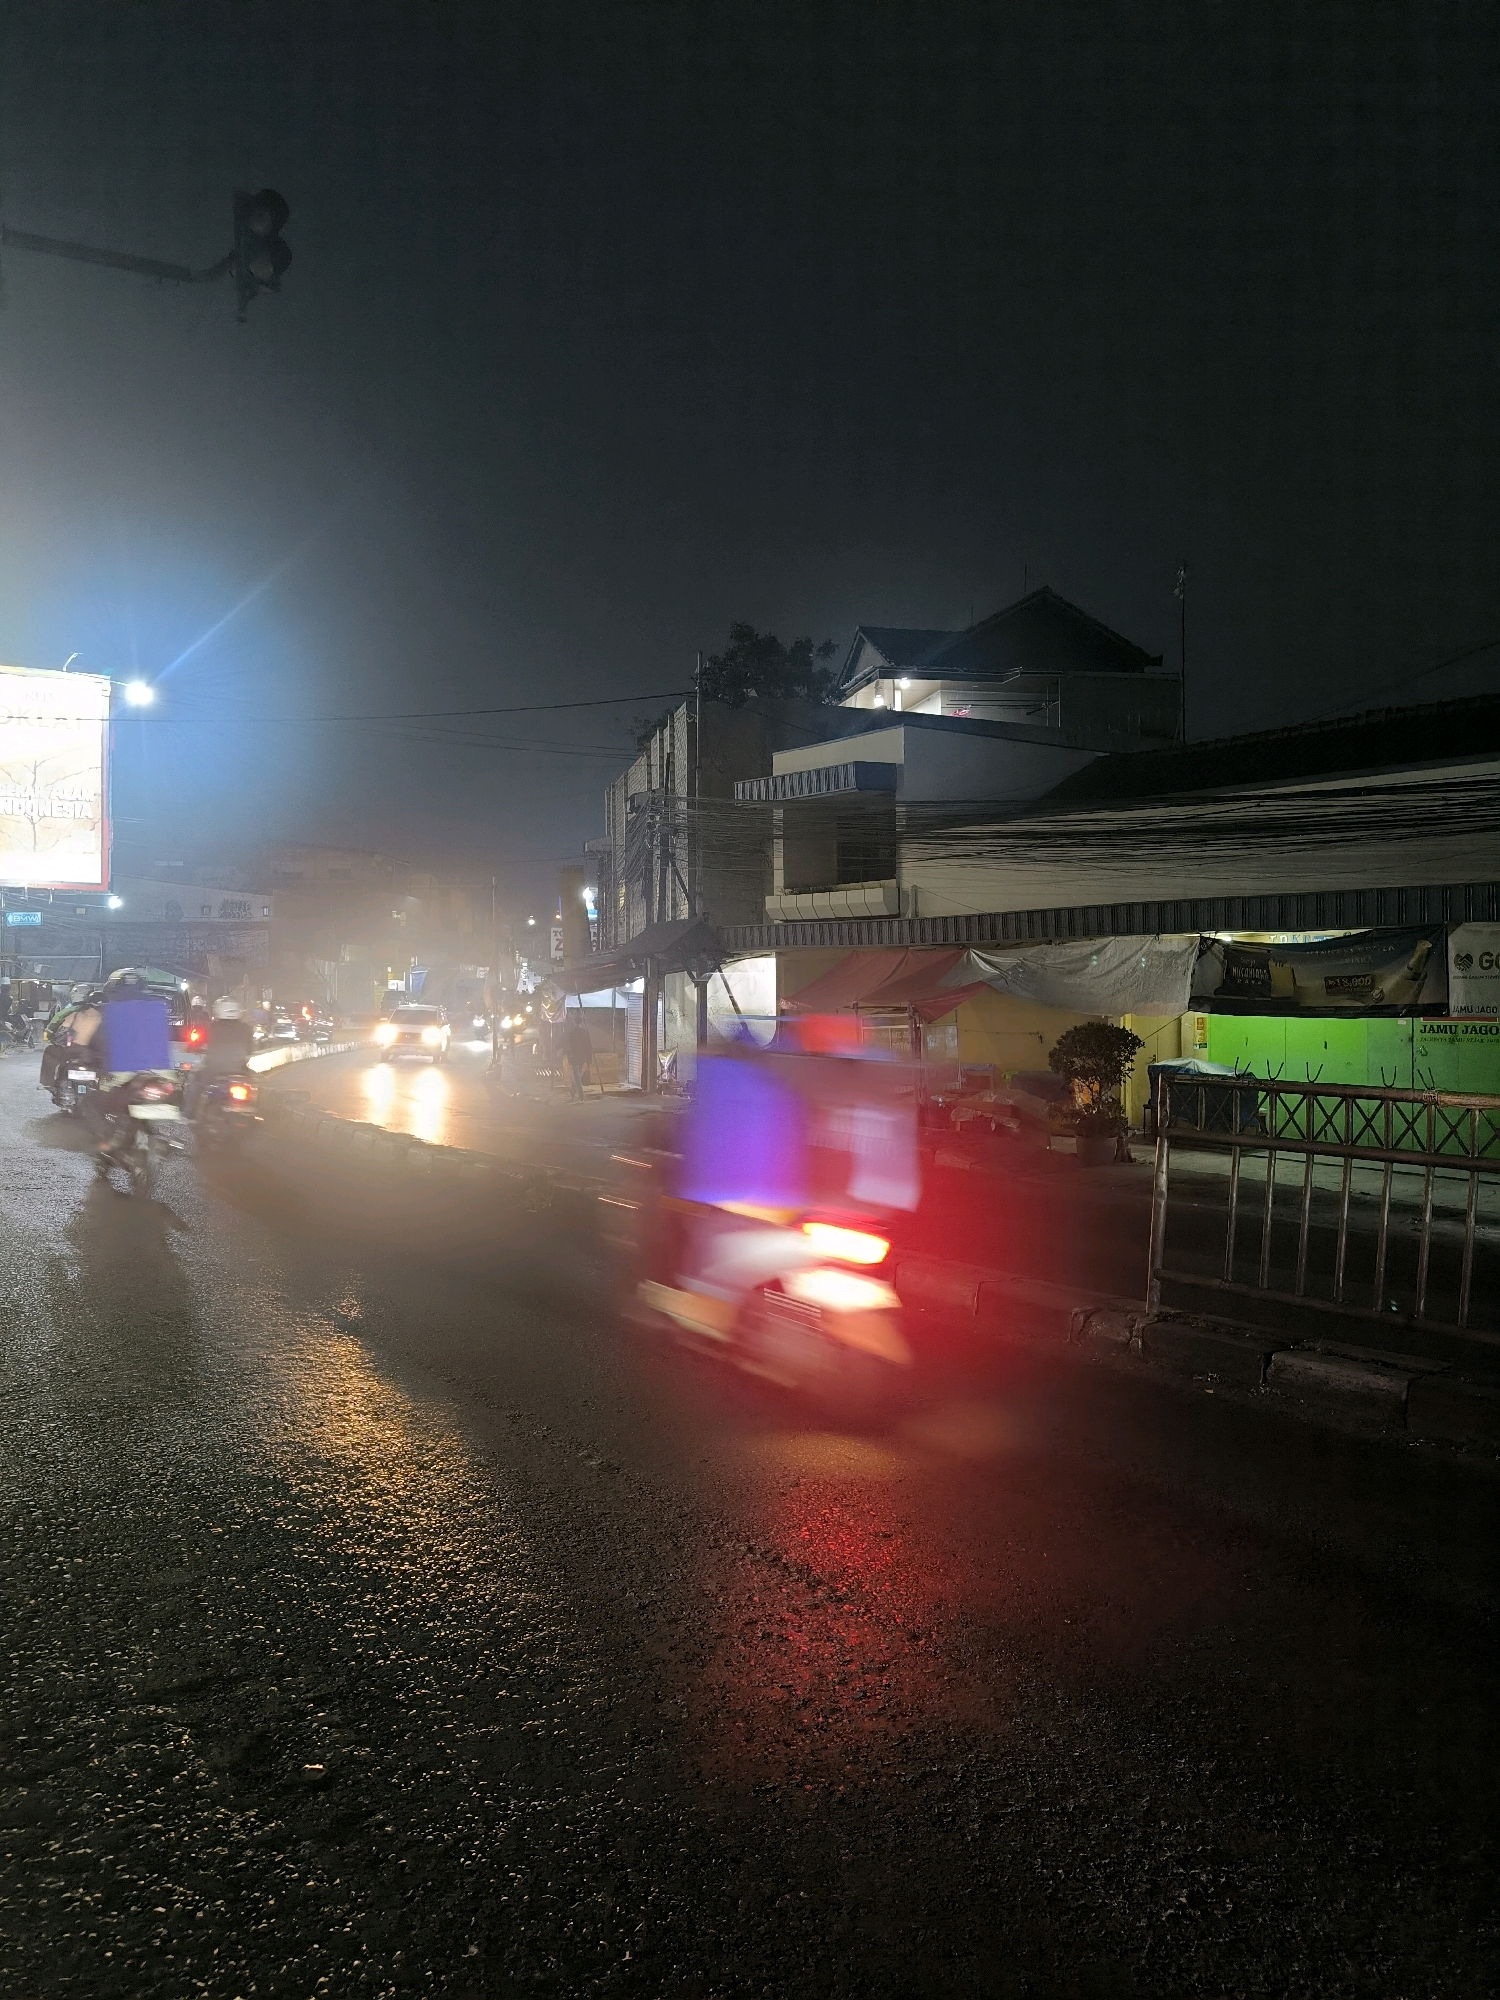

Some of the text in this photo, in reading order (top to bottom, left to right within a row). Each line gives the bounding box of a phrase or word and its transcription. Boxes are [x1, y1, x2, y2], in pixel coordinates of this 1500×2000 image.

[1453, 1005, 1498, 1014] JAMU JAGO
[1420, 1024, 1500, 1036] JAMU JAGO
